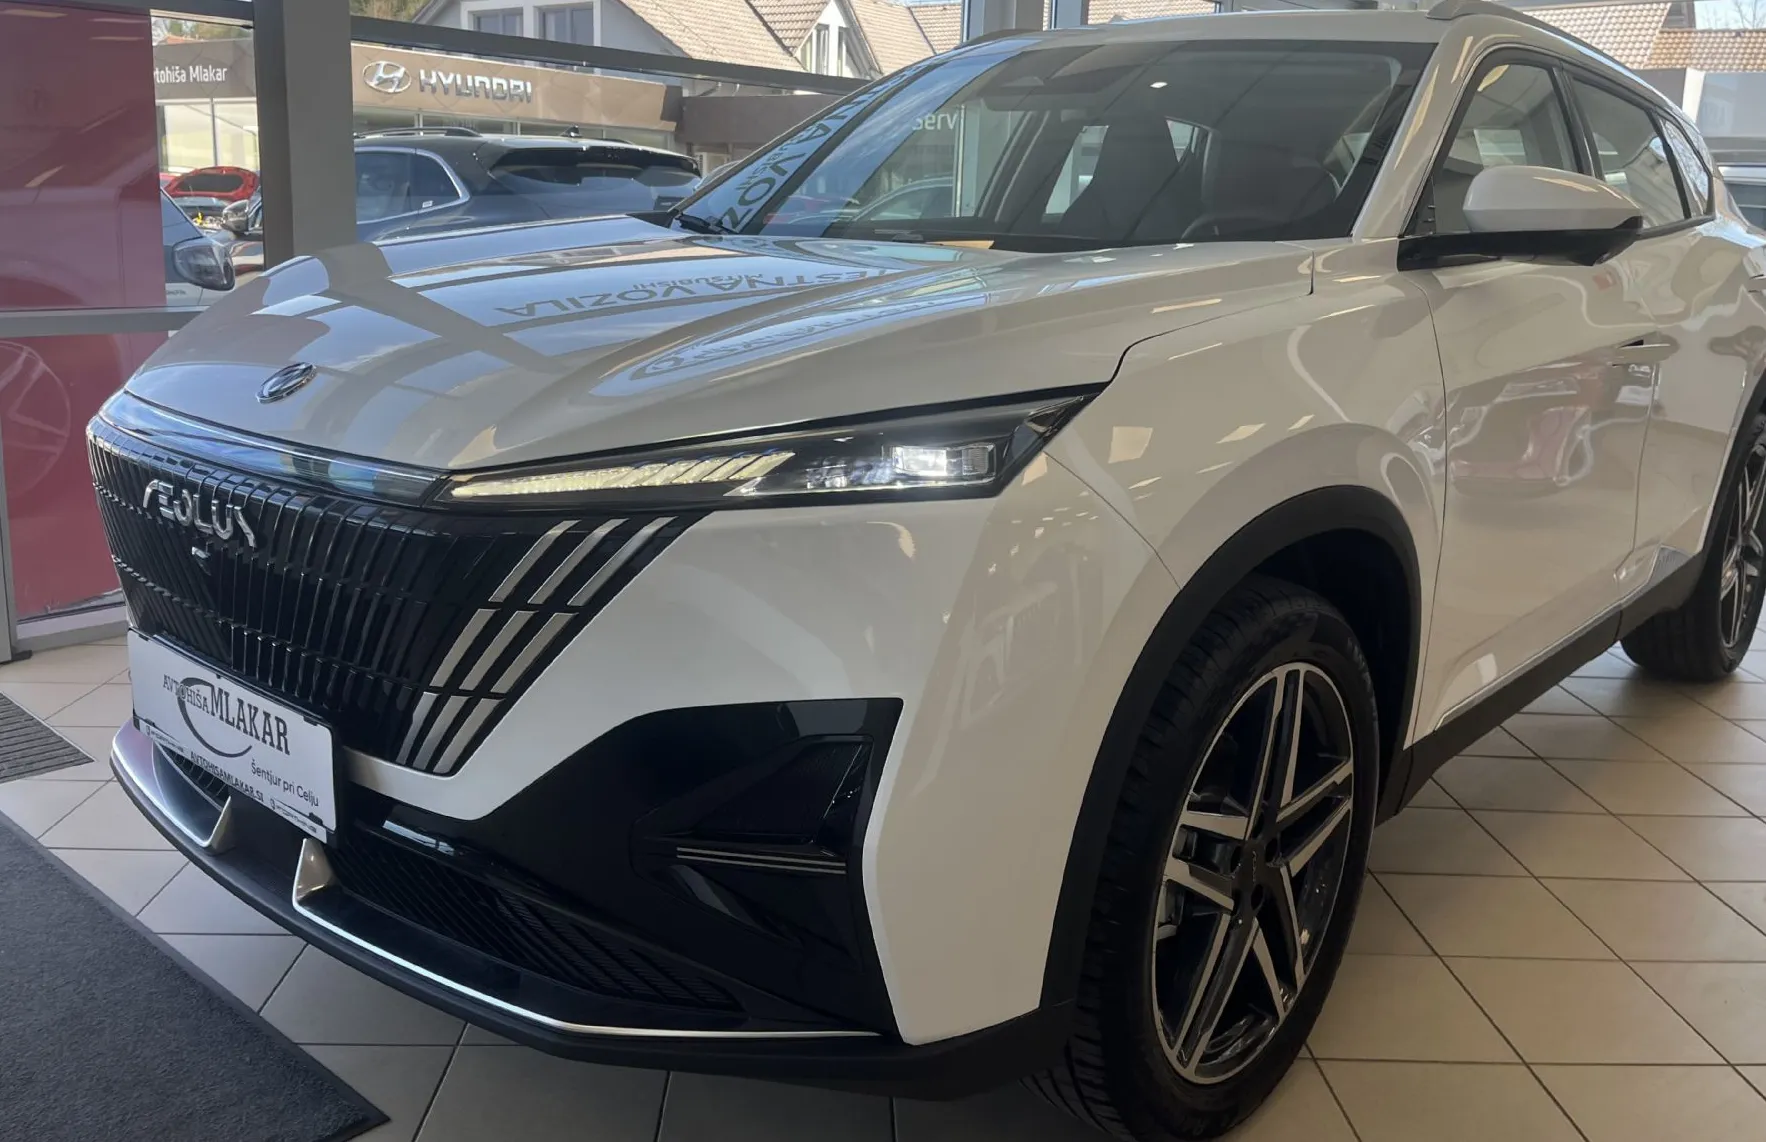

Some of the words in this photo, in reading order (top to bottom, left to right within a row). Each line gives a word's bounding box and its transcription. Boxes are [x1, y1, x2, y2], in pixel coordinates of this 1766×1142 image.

[189, 64, 228, 82] Mlakar
[419, 69, 532, 104] HYUNDAI
[494, 285, 698, 317] VOZILA
[163, 674, 210, 715] AVTOHIŠA
[210, 684, 291, 756] MLAKAR
[251, 757, 282, 787] Šentjur
[283, 780, 295, 795] pri
[296, 785, 319, 807] Celju
